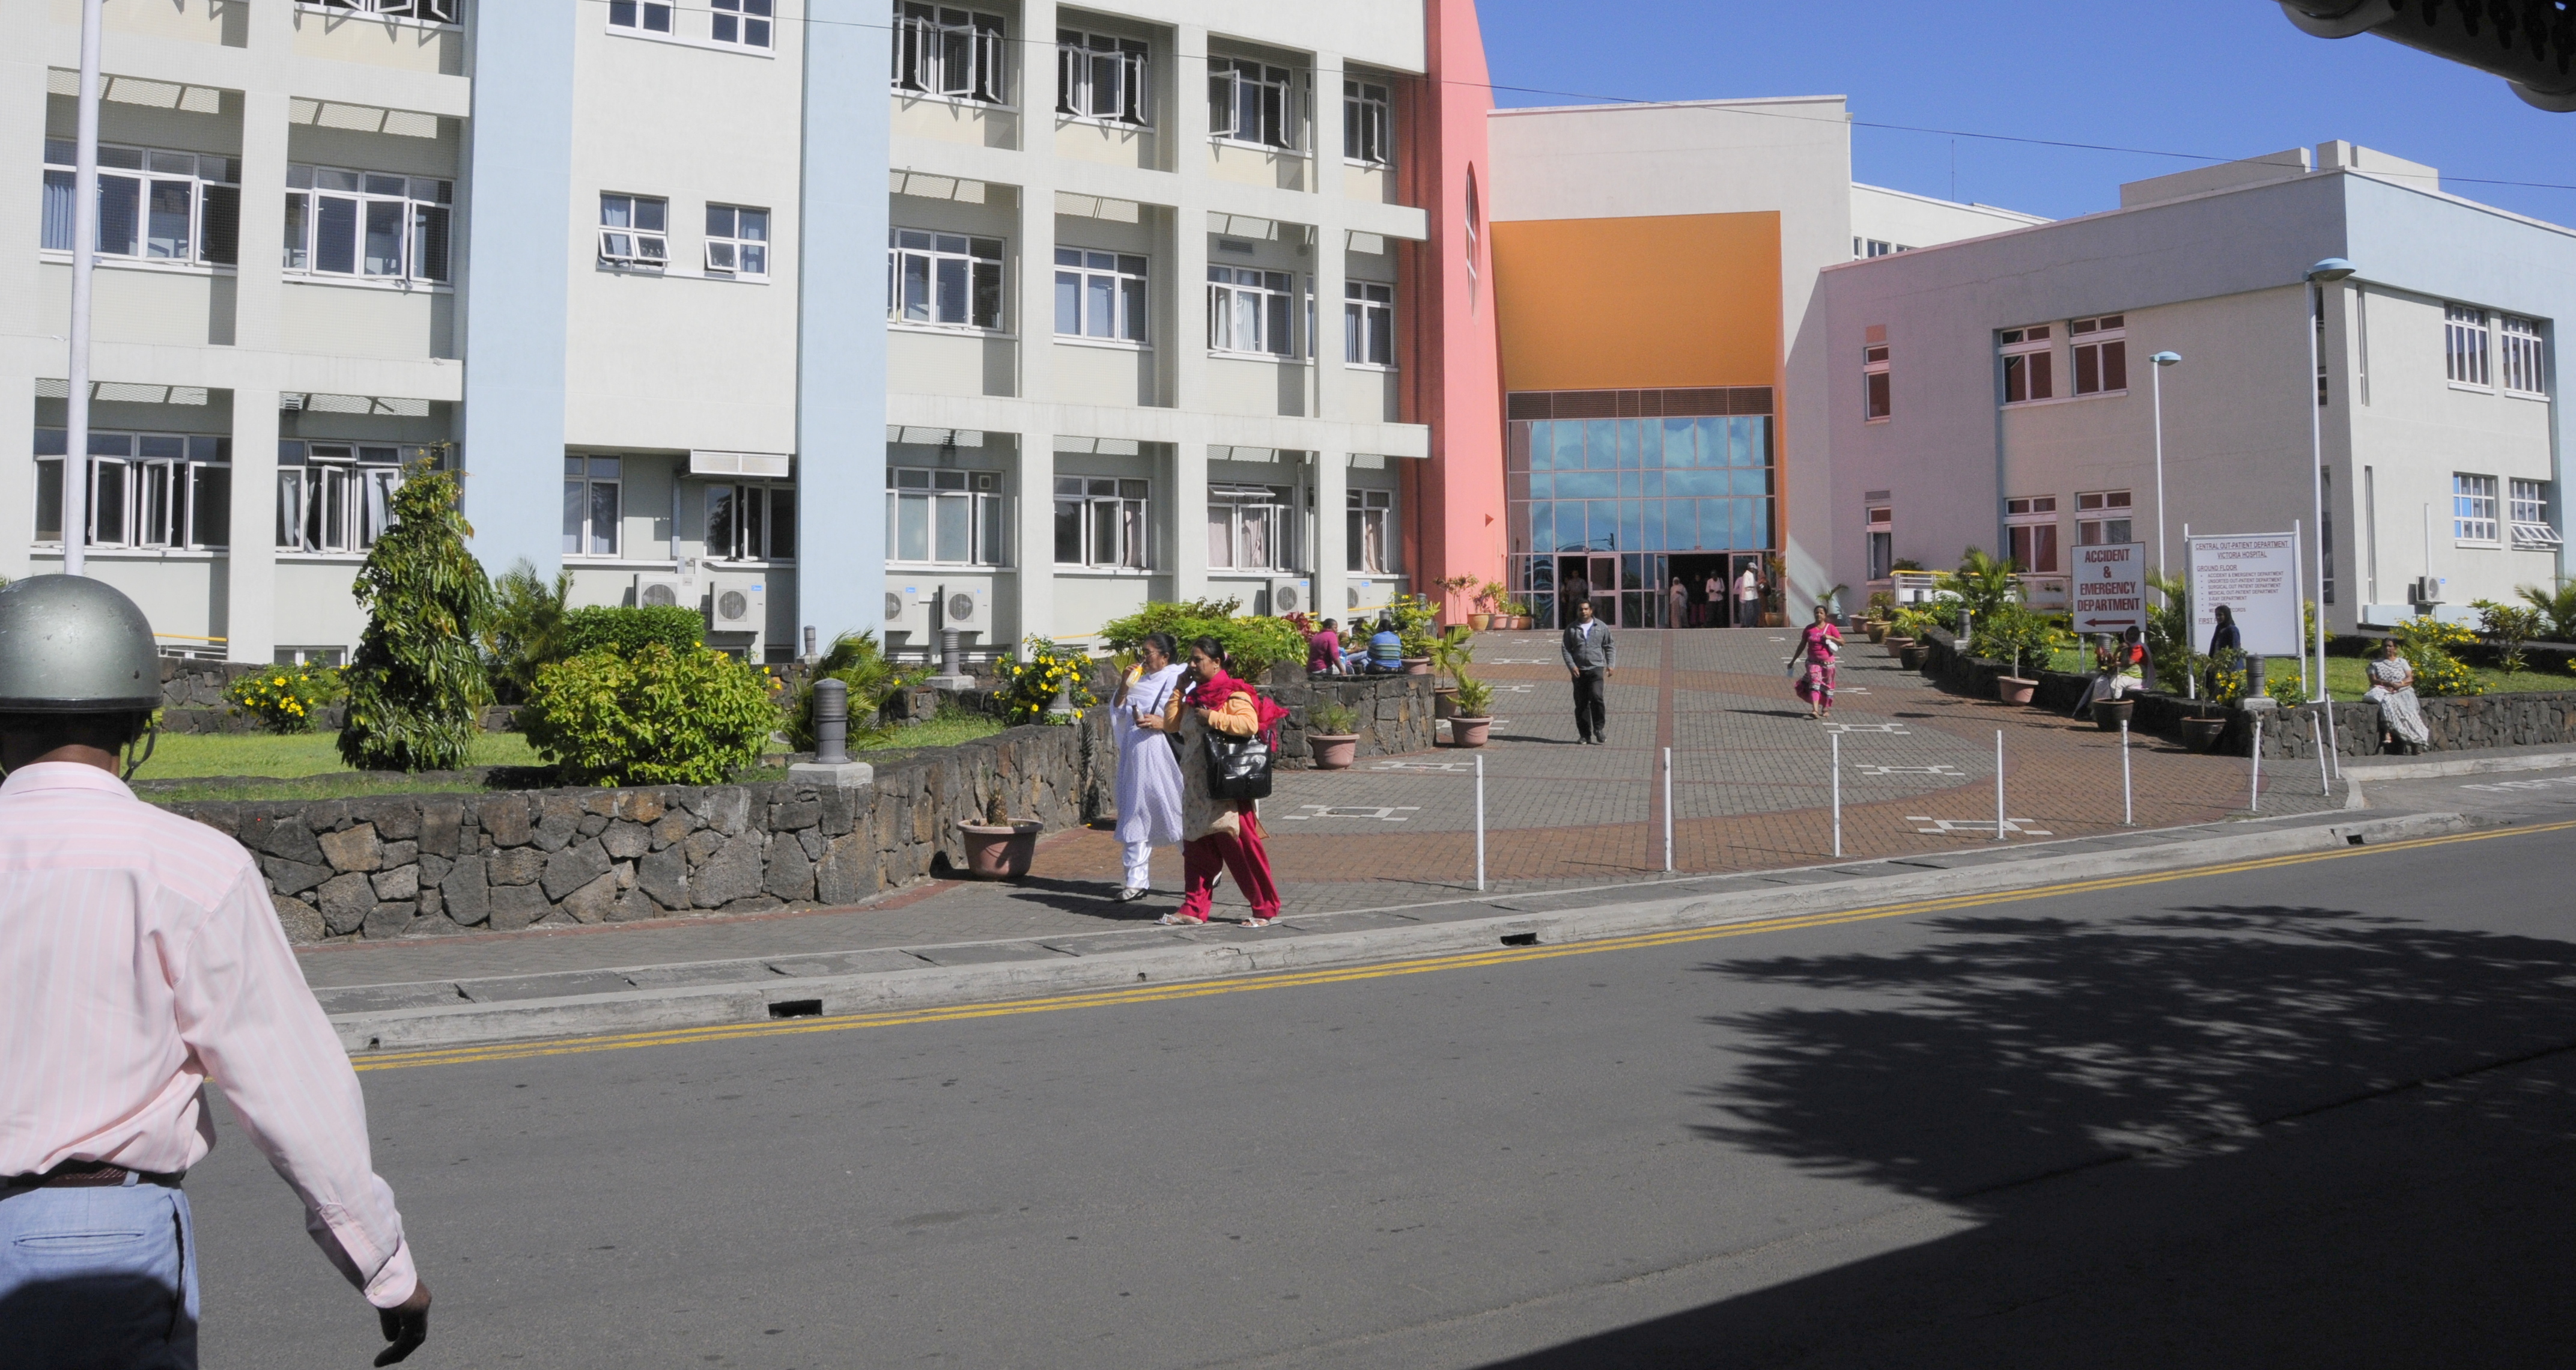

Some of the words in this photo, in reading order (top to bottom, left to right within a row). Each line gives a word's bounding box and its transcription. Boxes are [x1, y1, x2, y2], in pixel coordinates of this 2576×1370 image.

[2085, 549, 2130, 562] ACCIDENT
[2103, 566, 2111, 579] &
[2080, 582, 2136, 595] EMERGENCY
[2077, 598, 2140, 612] DEPARTMENT
